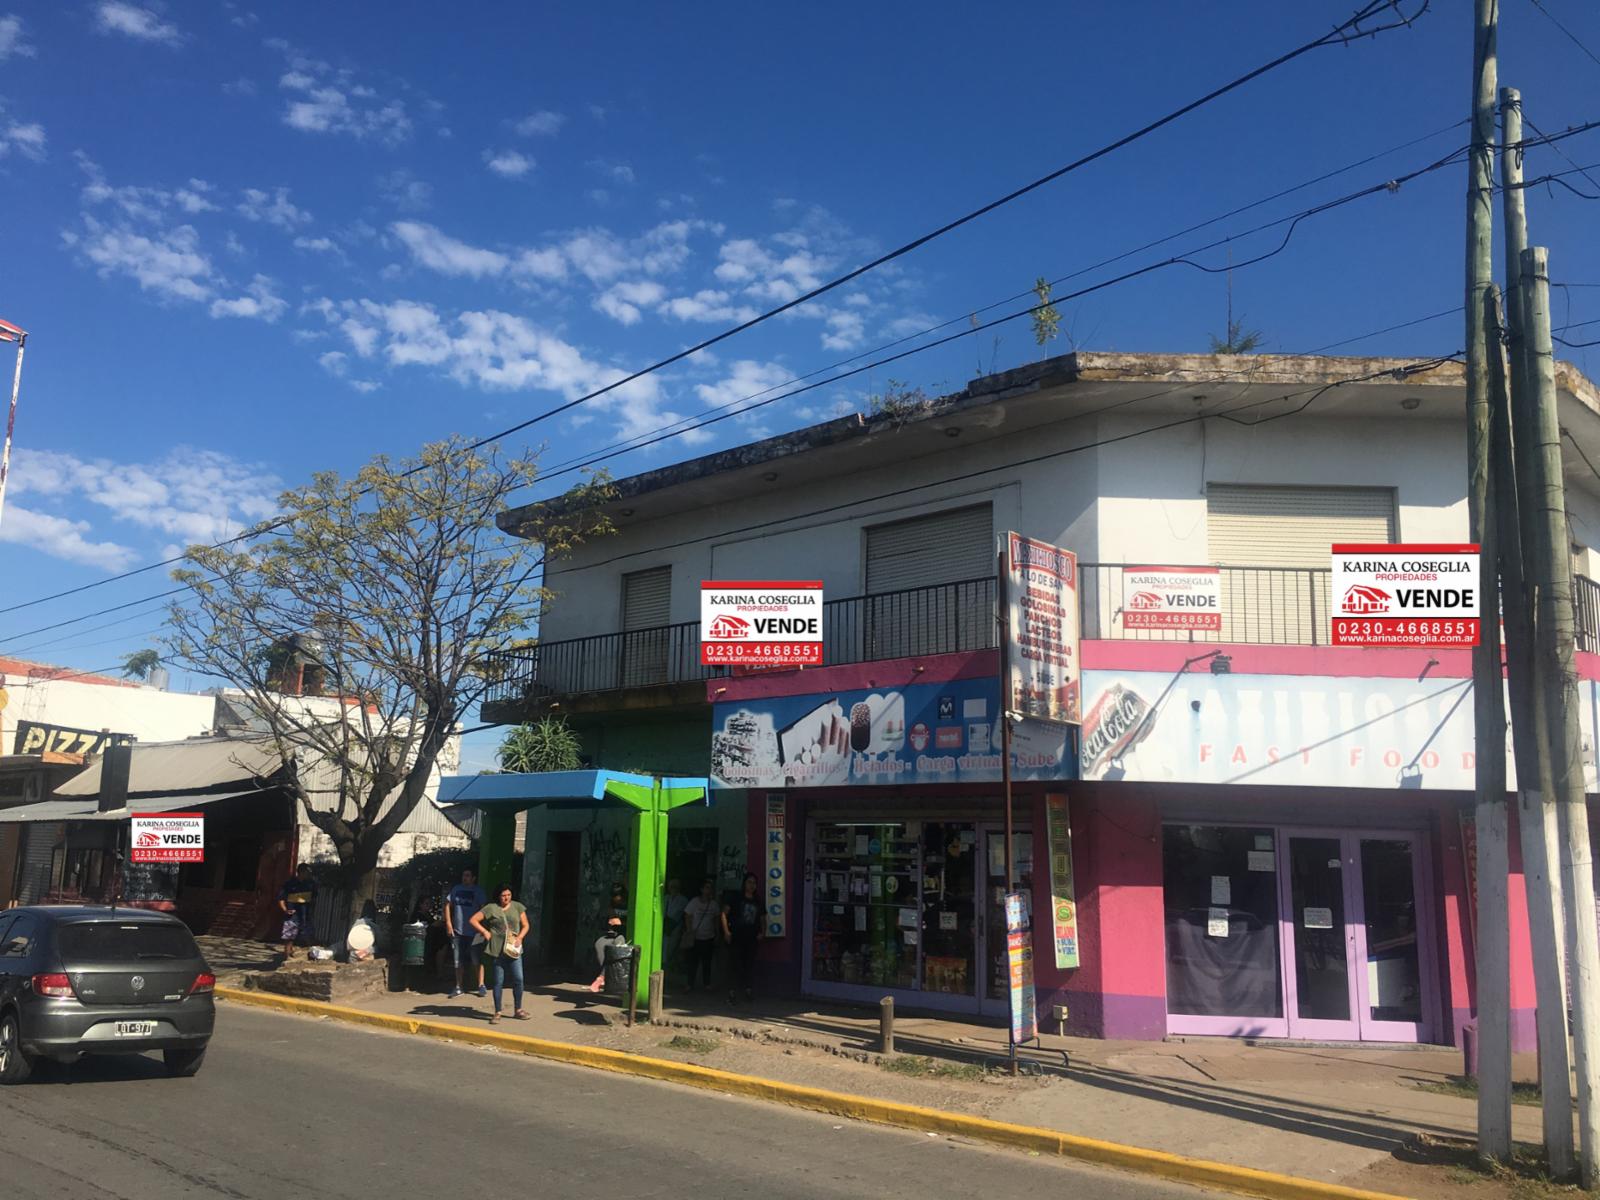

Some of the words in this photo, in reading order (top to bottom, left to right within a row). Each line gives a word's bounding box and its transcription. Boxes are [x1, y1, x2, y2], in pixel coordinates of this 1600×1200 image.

[1027, 569, 1037, 583] LO
[1038, 572, 1048, 586] DE
[1130, 576, 1167, 585] KARINA
[1168, 577, 1214, 586] COSEGLIA
[1026, 585, 1060, 604] BEBIDAS
[1165, 594, 1217, 607] VENDE
[1020, 596, 1066, 618] GOLOSINAS
[1024, 609, 1062, 629] PANCHOS
[1025, 621, 1062, 642] LACTEOS
[1021, 647, 1043, 662] CARGA
[916, 754, 956, 772] Carga
[1018, 752, 1056, 768] Sube
[1200, 744, 1312, 766] FAST
[1349, 747, 1476, 771] FOOD
[768, 831, 783, 935] KIOSCO
[135, 1023, 150, 1033] 977
